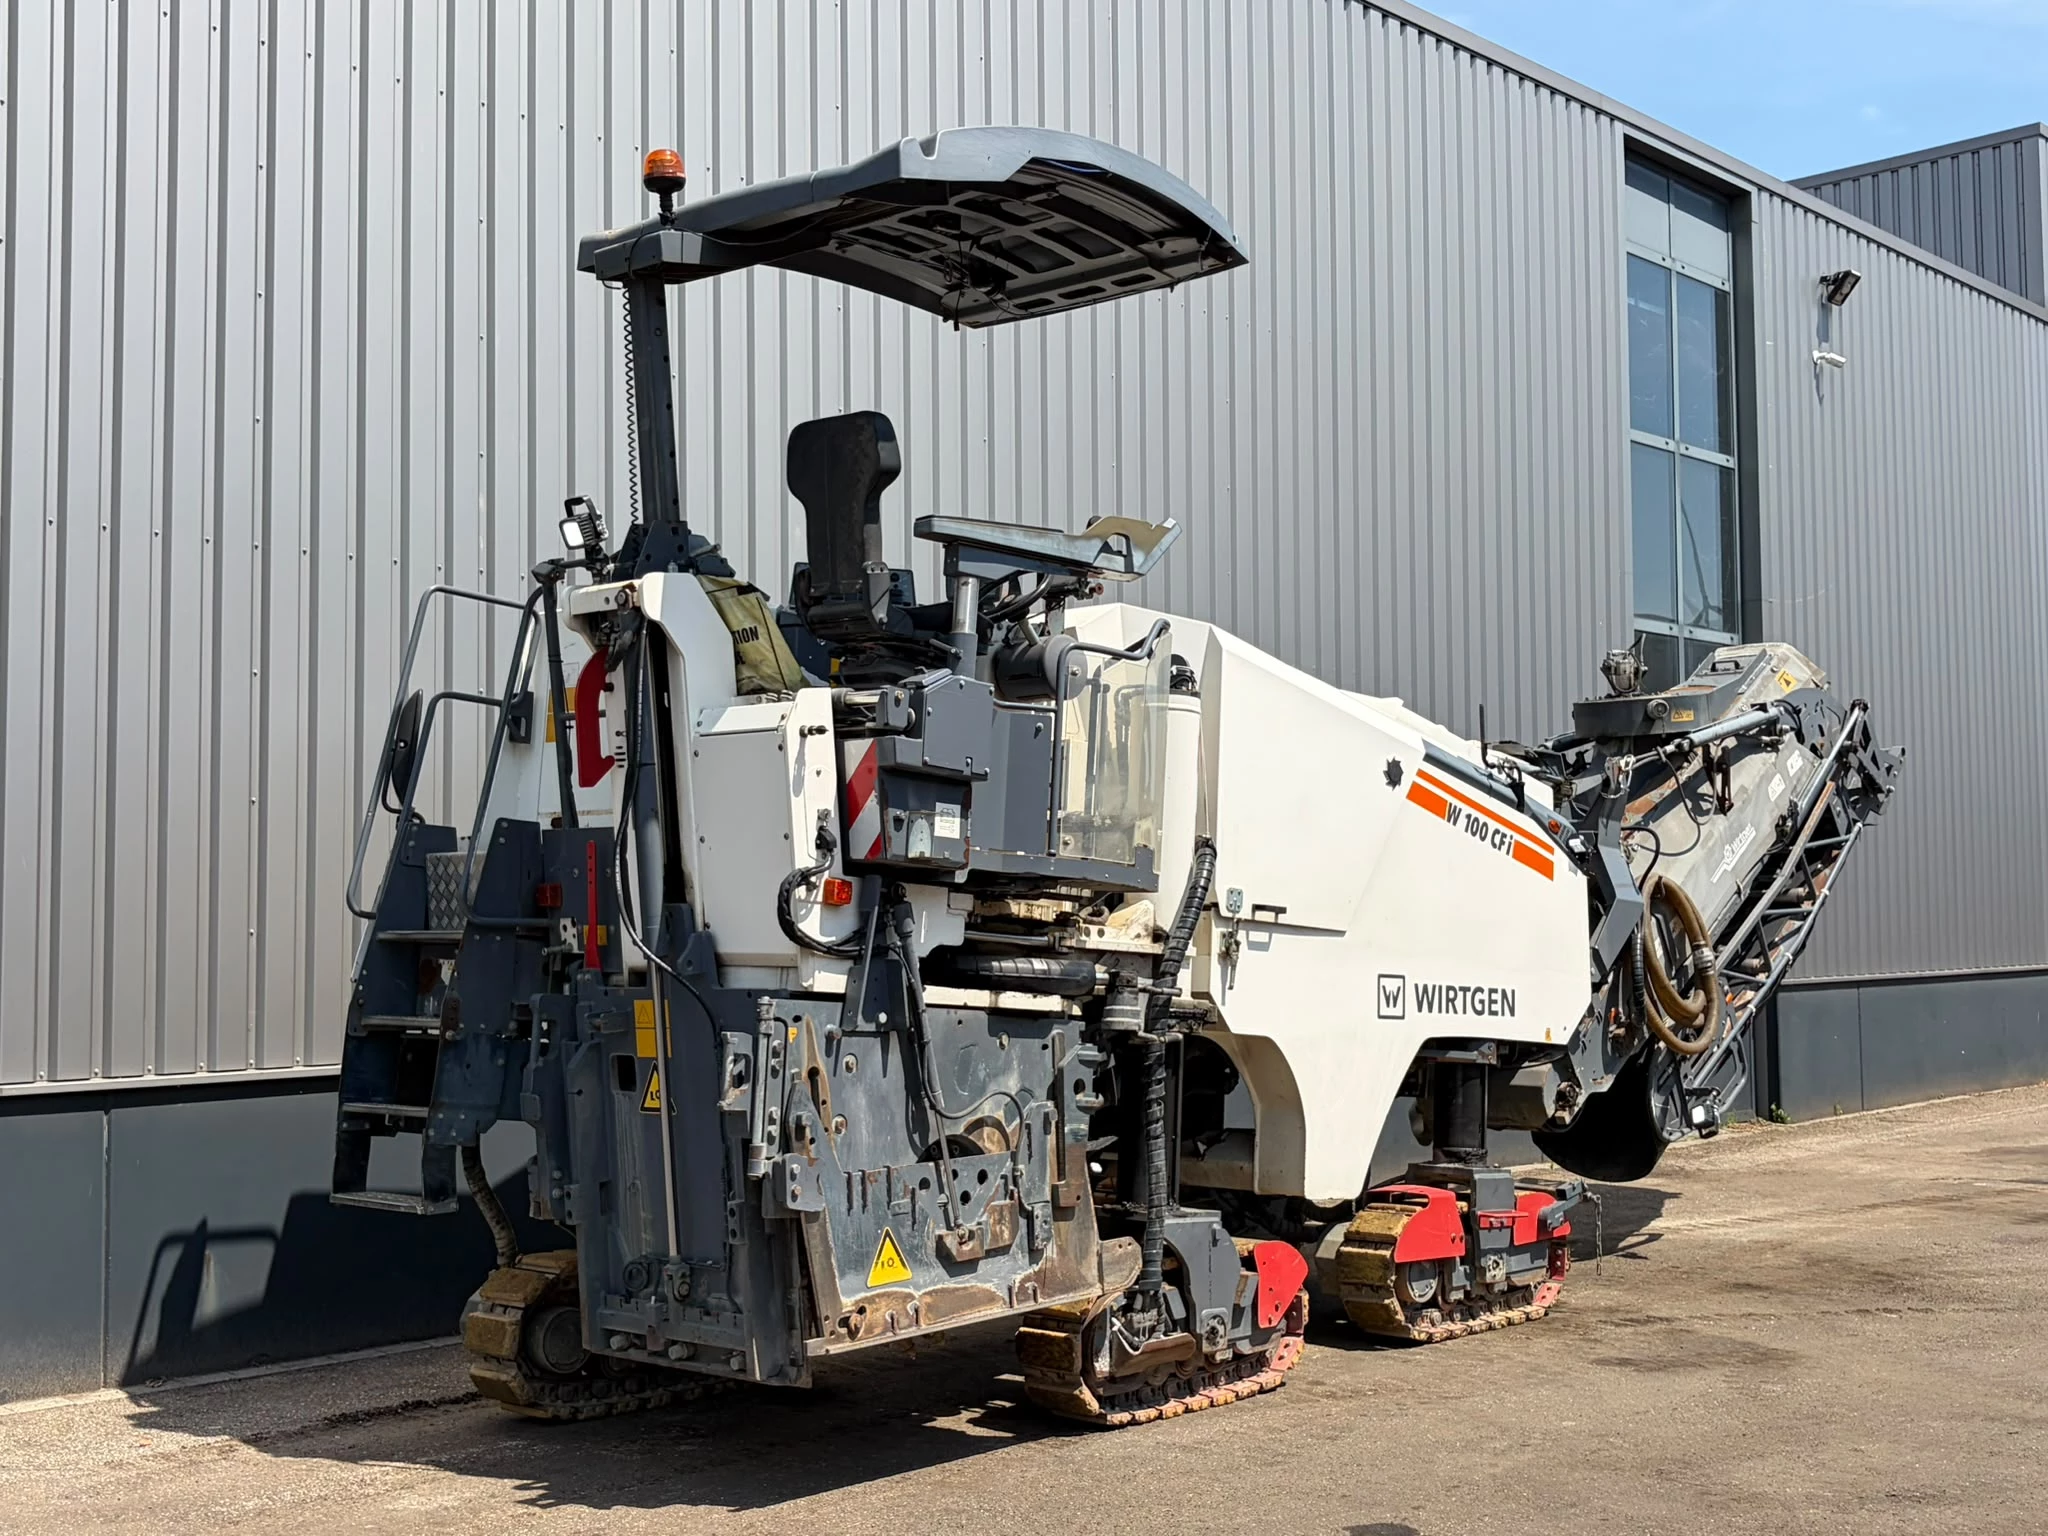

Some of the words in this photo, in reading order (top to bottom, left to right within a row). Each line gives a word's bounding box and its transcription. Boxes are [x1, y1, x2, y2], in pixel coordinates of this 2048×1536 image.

[1446, 802, 1462, 827] W
[1464, 813, 1489, 842] 100
[1414, 983, 1515, 1017] WIRTGEN
